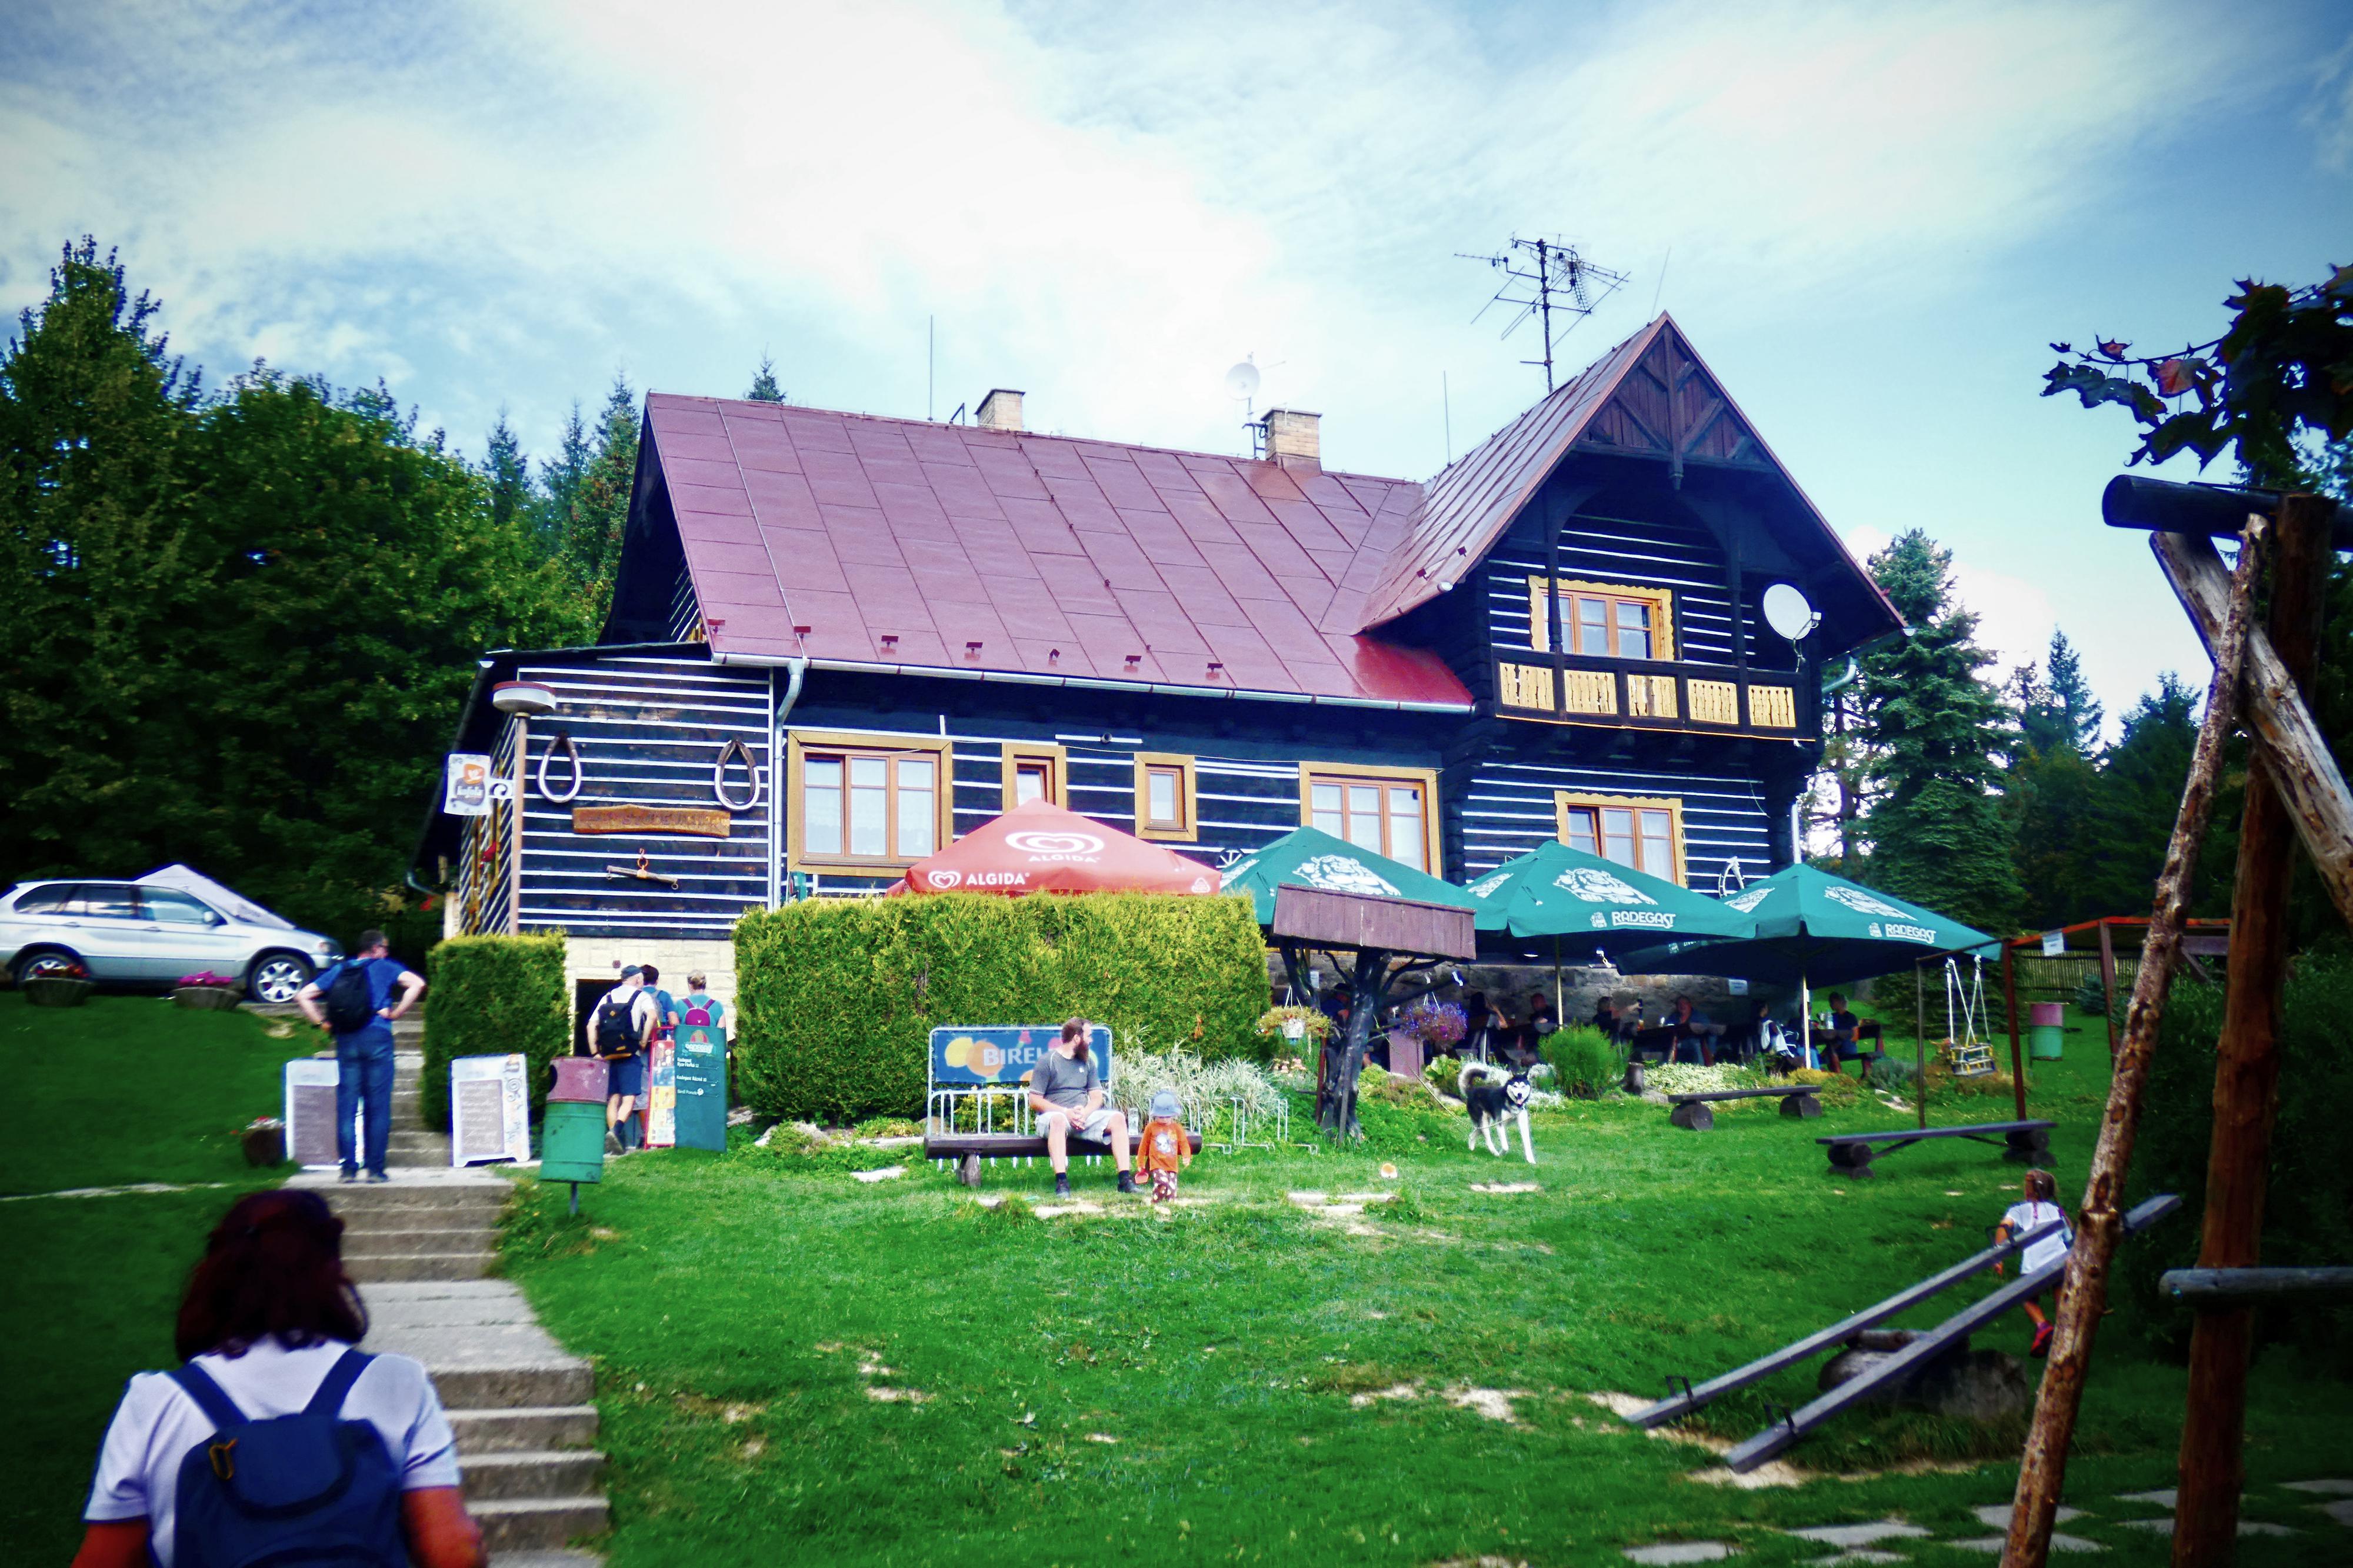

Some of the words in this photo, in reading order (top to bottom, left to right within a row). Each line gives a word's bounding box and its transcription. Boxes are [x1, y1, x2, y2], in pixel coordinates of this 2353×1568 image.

[1028, 855, 1097, 863] ALGIDA
[966, 872, 1026, 885] ALGIDA
[1612, 912, 1676, 929] RADEGAST
[1885, 923, 1937, 944] RADEGAST
